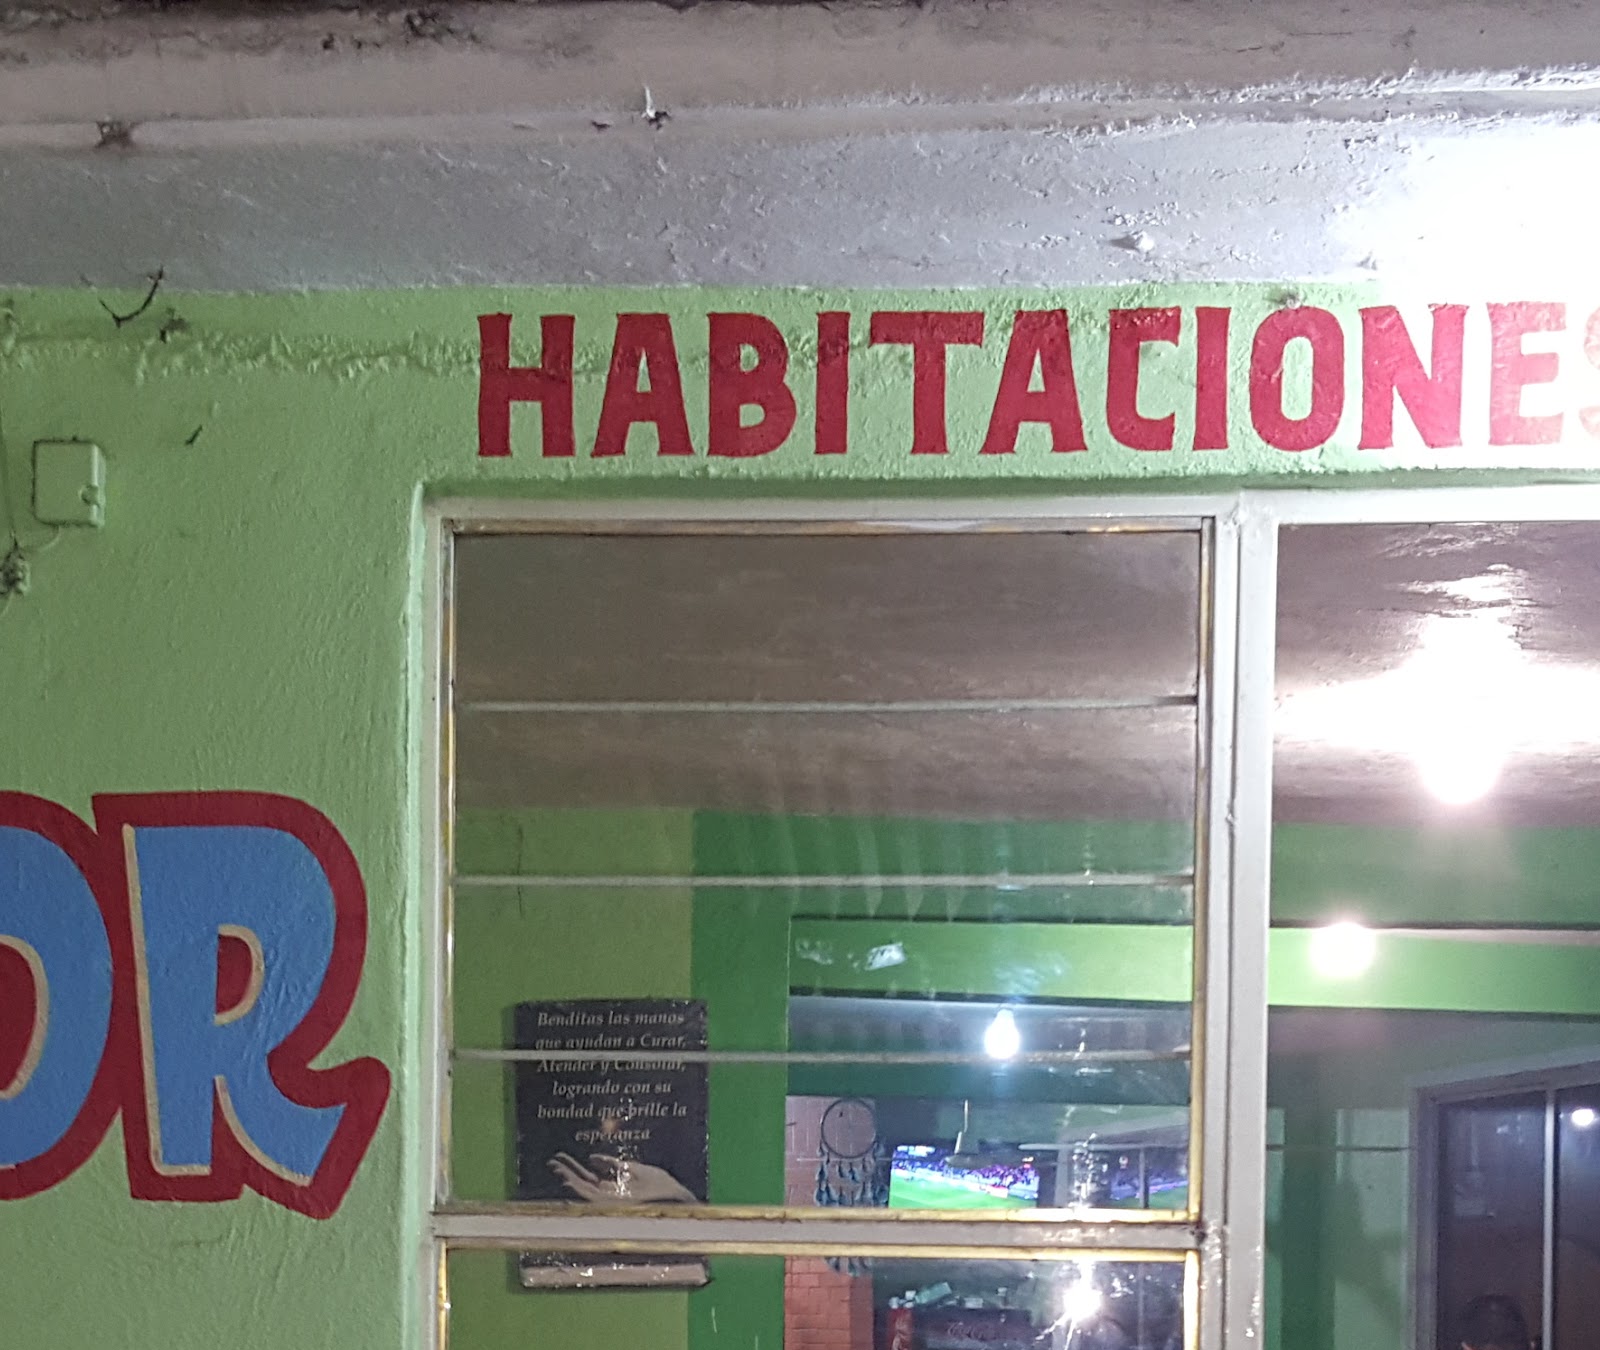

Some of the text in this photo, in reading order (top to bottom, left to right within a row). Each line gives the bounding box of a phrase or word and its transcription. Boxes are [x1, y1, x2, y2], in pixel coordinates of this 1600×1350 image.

[537, 1010, 685, 1027] Benditas las manos
[535, 1035, 562, 1050] que
[565, 1033, 622, 1050] ayudan
[625, 1036, 636, 1048] a
[600, 1060, 610, 1075] y
[551, 1079, 672, 1098] logrando con su
[536, 1102, 688, 1121] bondad que brille la
[574, 1128, 651, 1145] esperanza
